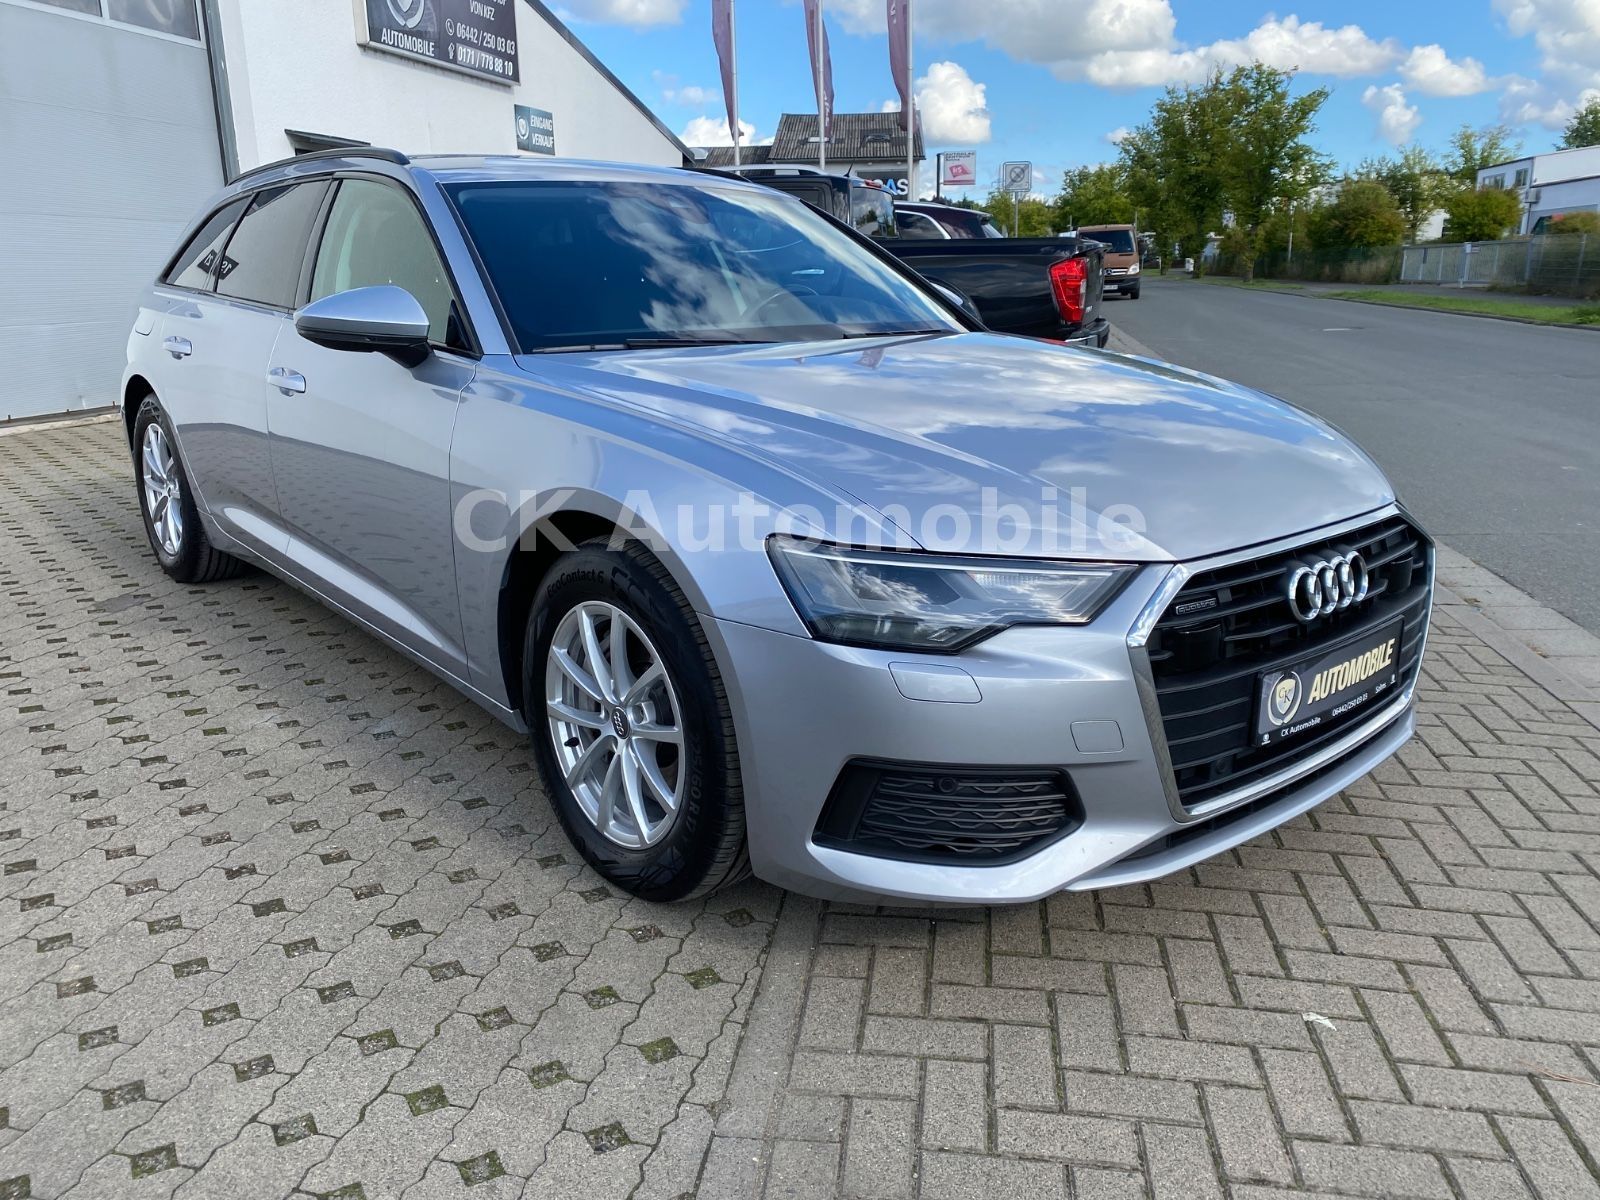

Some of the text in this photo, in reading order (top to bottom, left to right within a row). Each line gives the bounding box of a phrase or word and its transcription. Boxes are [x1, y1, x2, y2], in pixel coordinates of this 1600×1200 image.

[470, 0, 495, 21] VON KFZ
[381, 27, 435, 57] AUTOMOBILE
[456, 23, 478, 43] 06442
[483, 33, 496, 49] 250
[496, 37, 505, 52] 03
[506, 40, 516, 56] 03
[457, 46, 475, 66] 0171
[481, 51, 494, 71] 778
[494, 57, 503, 74] 88
[504, 61, 513, 77] 10
[530, 115, 553, 132] EINGANG
[531, 132, 555, 148] VERKAUF
[546, 568, 605, 598] EcoContact 6
[1178, 599, 1217, 614] quattro
[1307, 638, 1397, 705] AUTOMOBILE
[1278, 687, 1291, 703] CK
[1281, 727, 1289, 737] CK
[1289, 717, 1322, 734] Automobile
